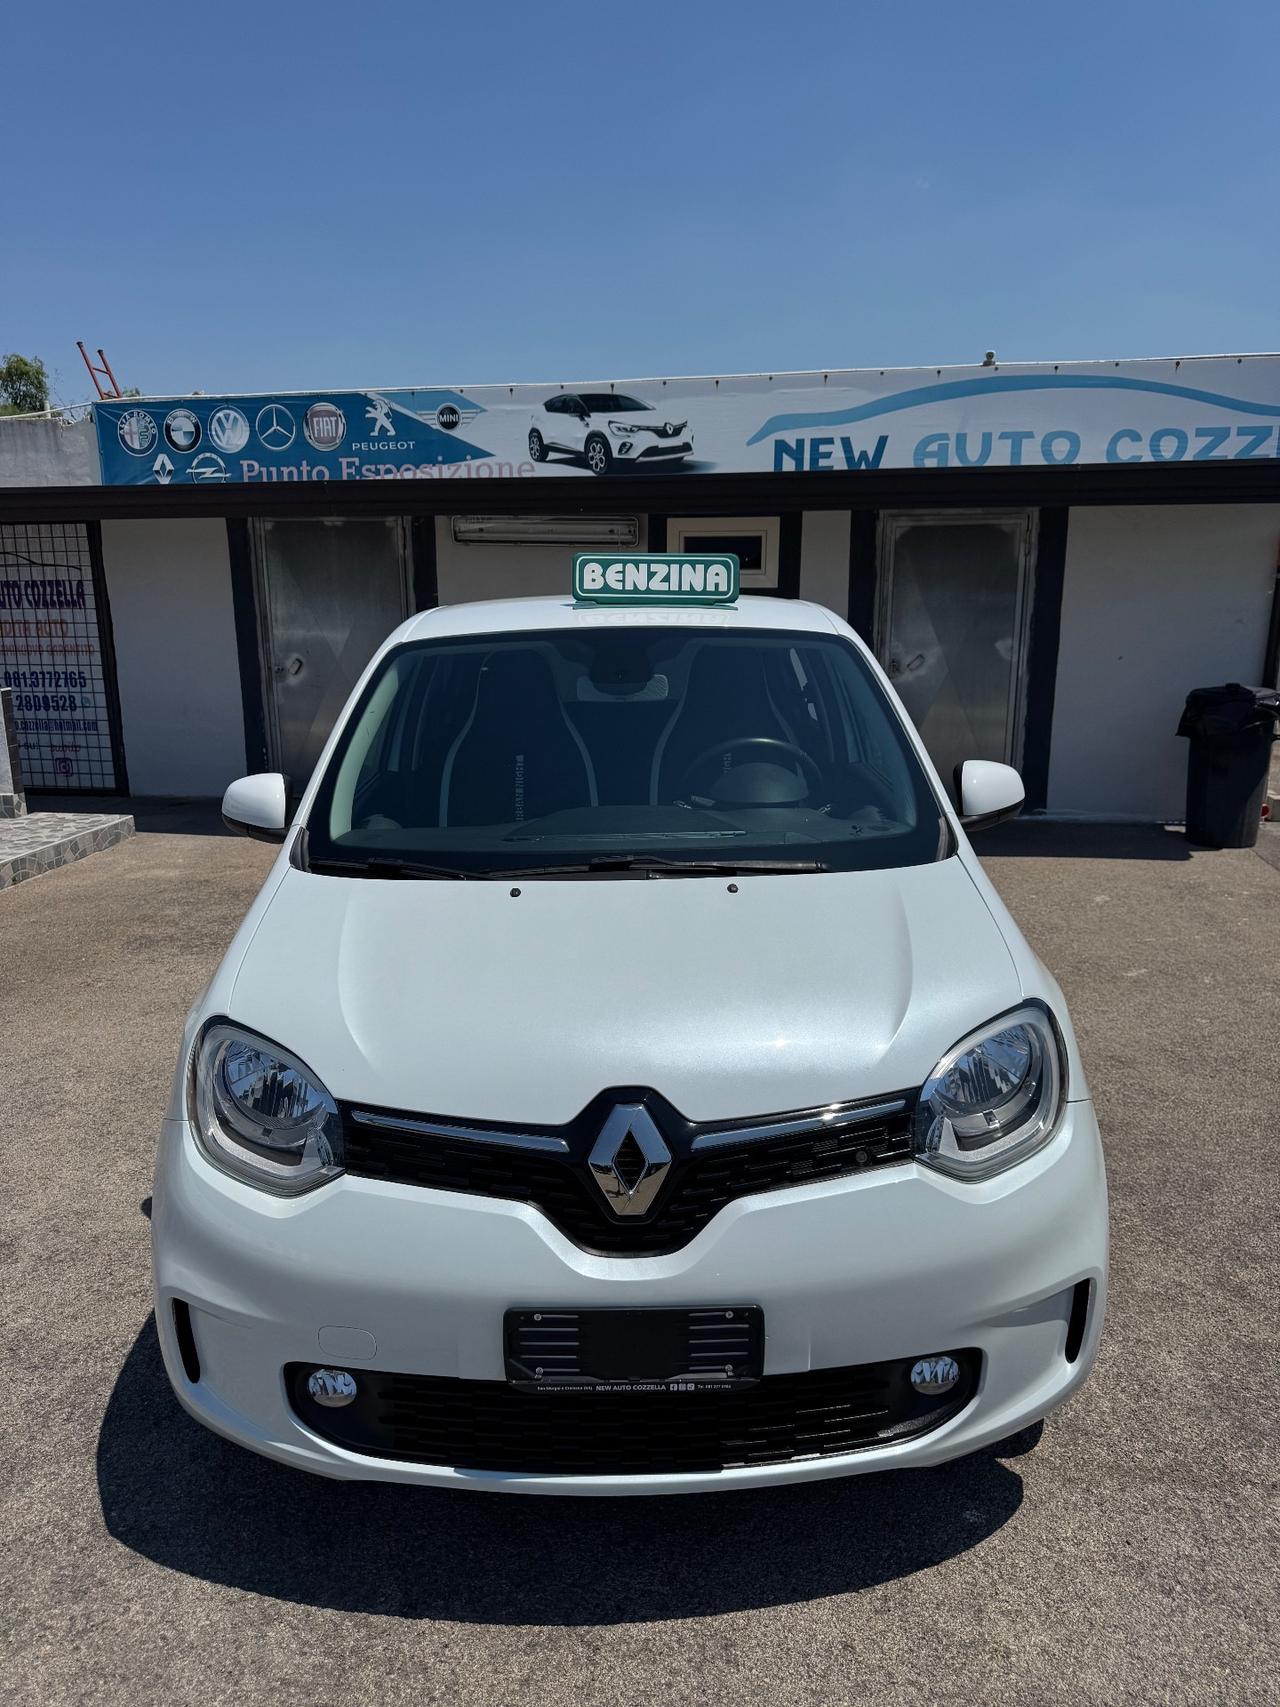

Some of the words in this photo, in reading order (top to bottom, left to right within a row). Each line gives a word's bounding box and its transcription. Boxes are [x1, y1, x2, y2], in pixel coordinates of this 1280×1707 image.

[313, 416, 338, 439] FIAT
[438, 413, 459, 423] MINI
[352, 441, 416, 451] PEUGEOT
[773, 435, 889, 472] NEW
[913, 431, 1081, 468] AUTO
[1104, 426, 1280, 463] COZZ
[239, 459, 330, 482] Punto
[338, 455, 536, 480] Esposizione
[583, 563, 728, 591] BENZINA
[24, 580, 86, 609] COZZELLA
[632, 1383, 666, 1391] COZZELLA
